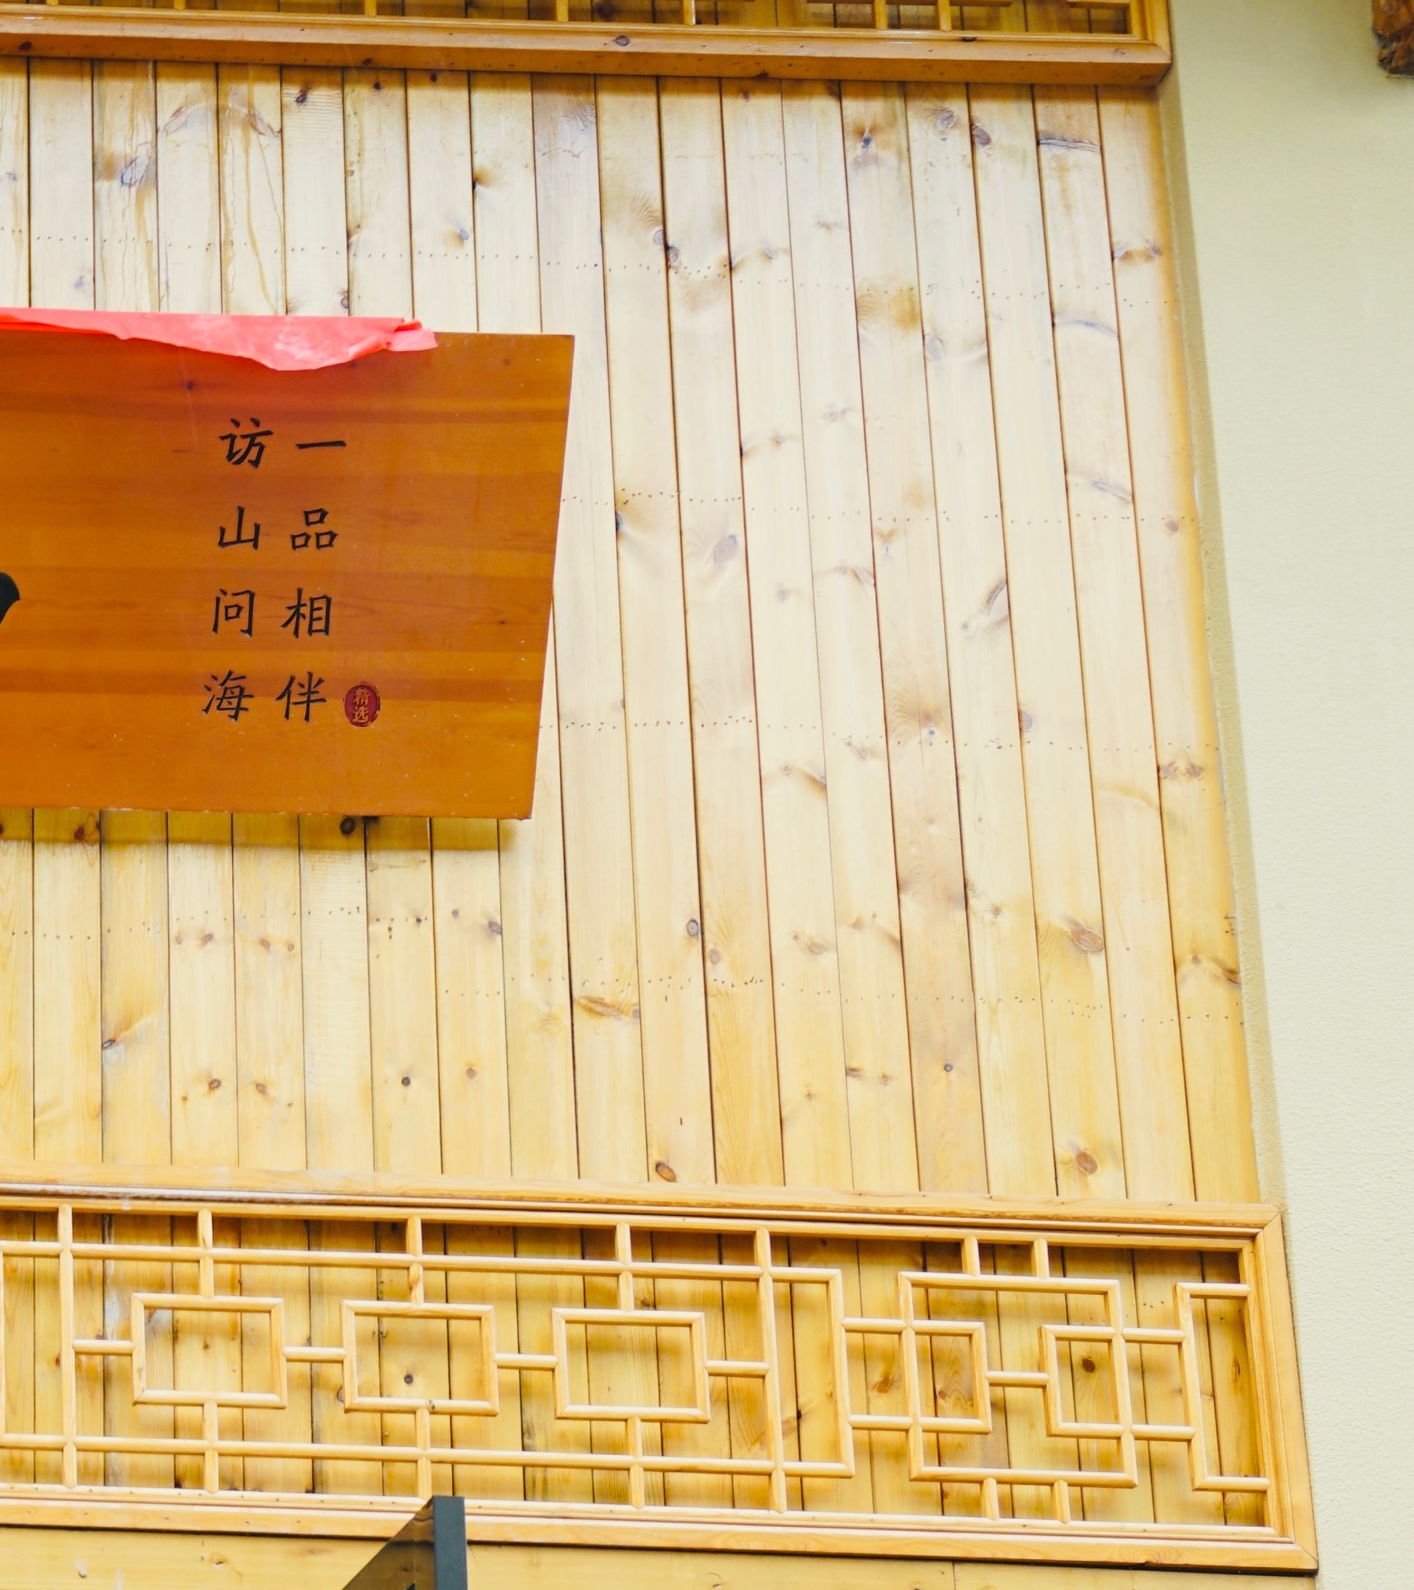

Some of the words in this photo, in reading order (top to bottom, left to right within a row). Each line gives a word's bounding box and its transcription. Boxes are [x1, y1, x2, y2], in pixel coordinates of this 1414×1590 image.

[202, 417, 274, 722] 访山问海
[275, 440, 347, 722] 一品相伴
